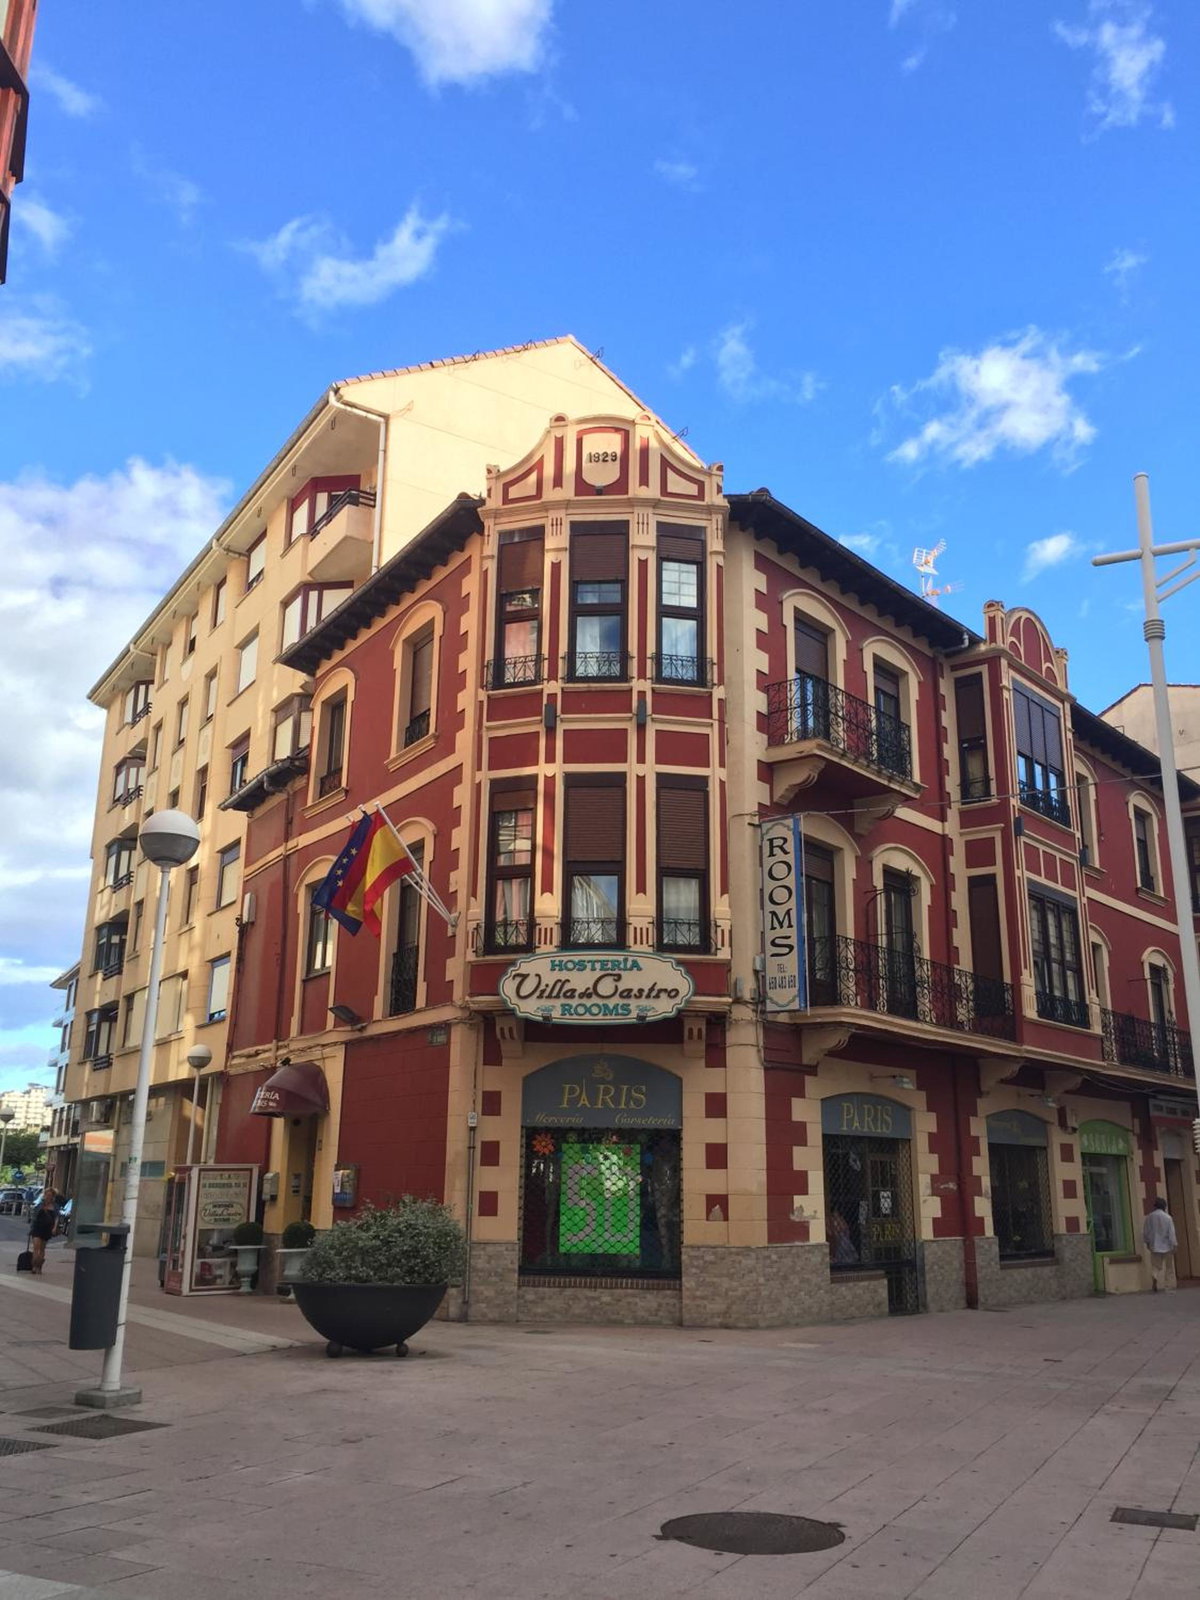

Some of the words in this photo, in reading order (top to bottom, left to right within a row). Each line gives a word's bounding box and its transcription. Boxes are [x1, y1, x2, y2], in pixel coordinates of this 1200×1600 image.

[588, 451, 618, 463] 1929
[766, 836, 795, 958] ROOMS
[550, 957, 643, 972] HOSTERÍA
[512, 972, 577, 1000] Villa
[592, 972, 680, 1000] Castro
[560, 1003, 632, 1017] ROOMS
[560, 1079, 647, 1109] PARIS
[840, 1101, 893, 1134] PARIS
